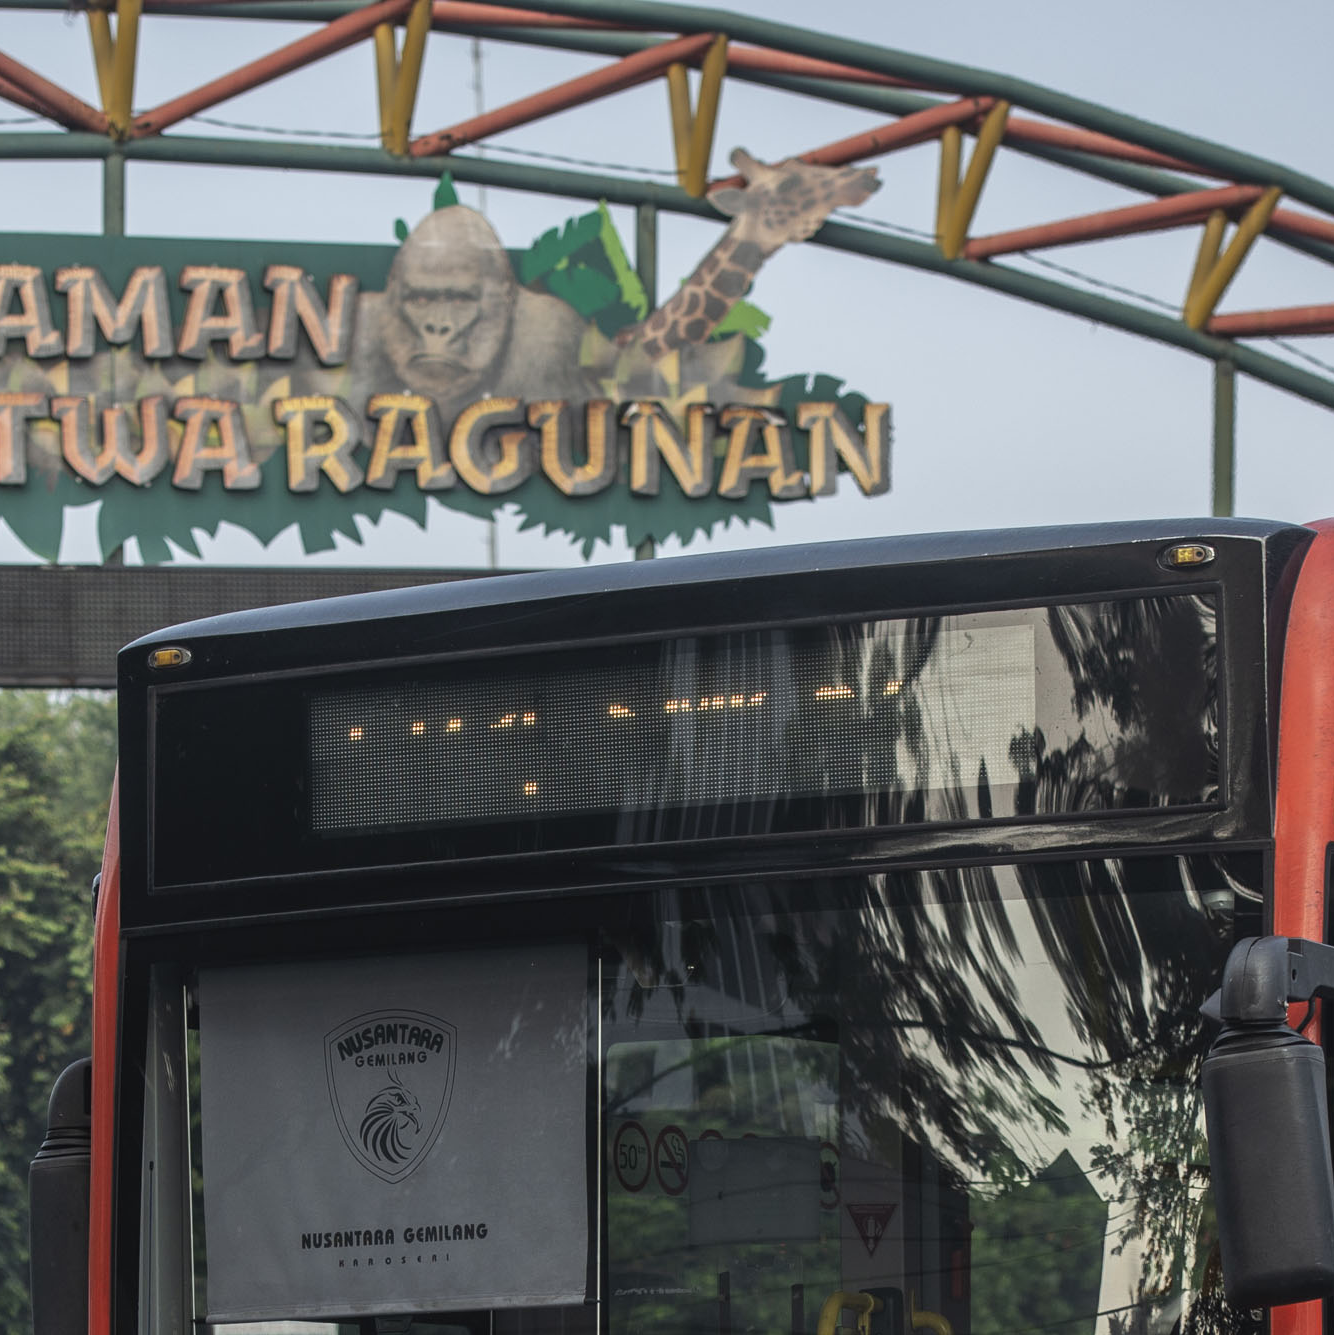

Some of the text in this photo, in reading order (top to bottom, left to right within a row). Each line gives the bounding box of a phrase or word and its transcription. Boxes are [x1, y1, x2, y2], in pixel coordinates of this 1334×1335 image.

[275, 392, 892, 498] RAGUNAN
[337, 1024, 444, 1061] NUSANTARA
[355, 1051, 427, 1068] GEMILANG
[301, 1222, 489, 1249] NUSANTARA GEMILANG
